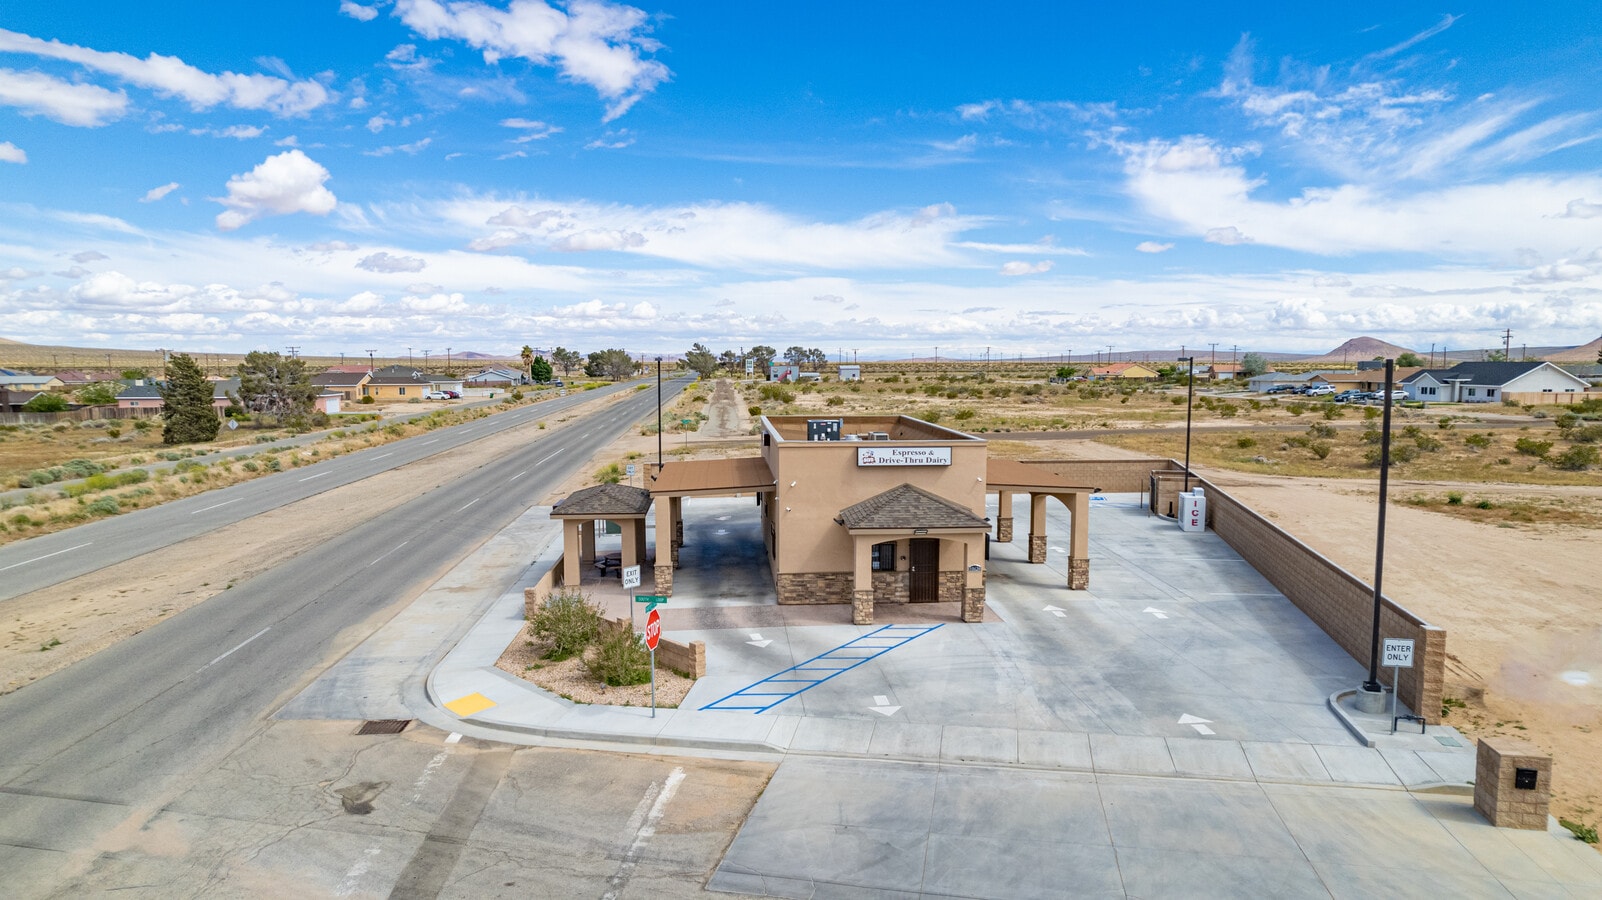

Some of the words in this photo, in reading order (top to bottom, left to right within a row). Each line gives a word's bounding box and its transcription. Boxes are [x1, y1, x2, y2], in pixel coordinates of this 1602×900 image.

[892, 449, 926, 457] Espresso
[1191, 500, 1199, 526] ICE
[646, 619, 660, 640] STOP
[1386, 644, 1411, 652] ENTER
[1387, 653, 1409, 661] ONLY
